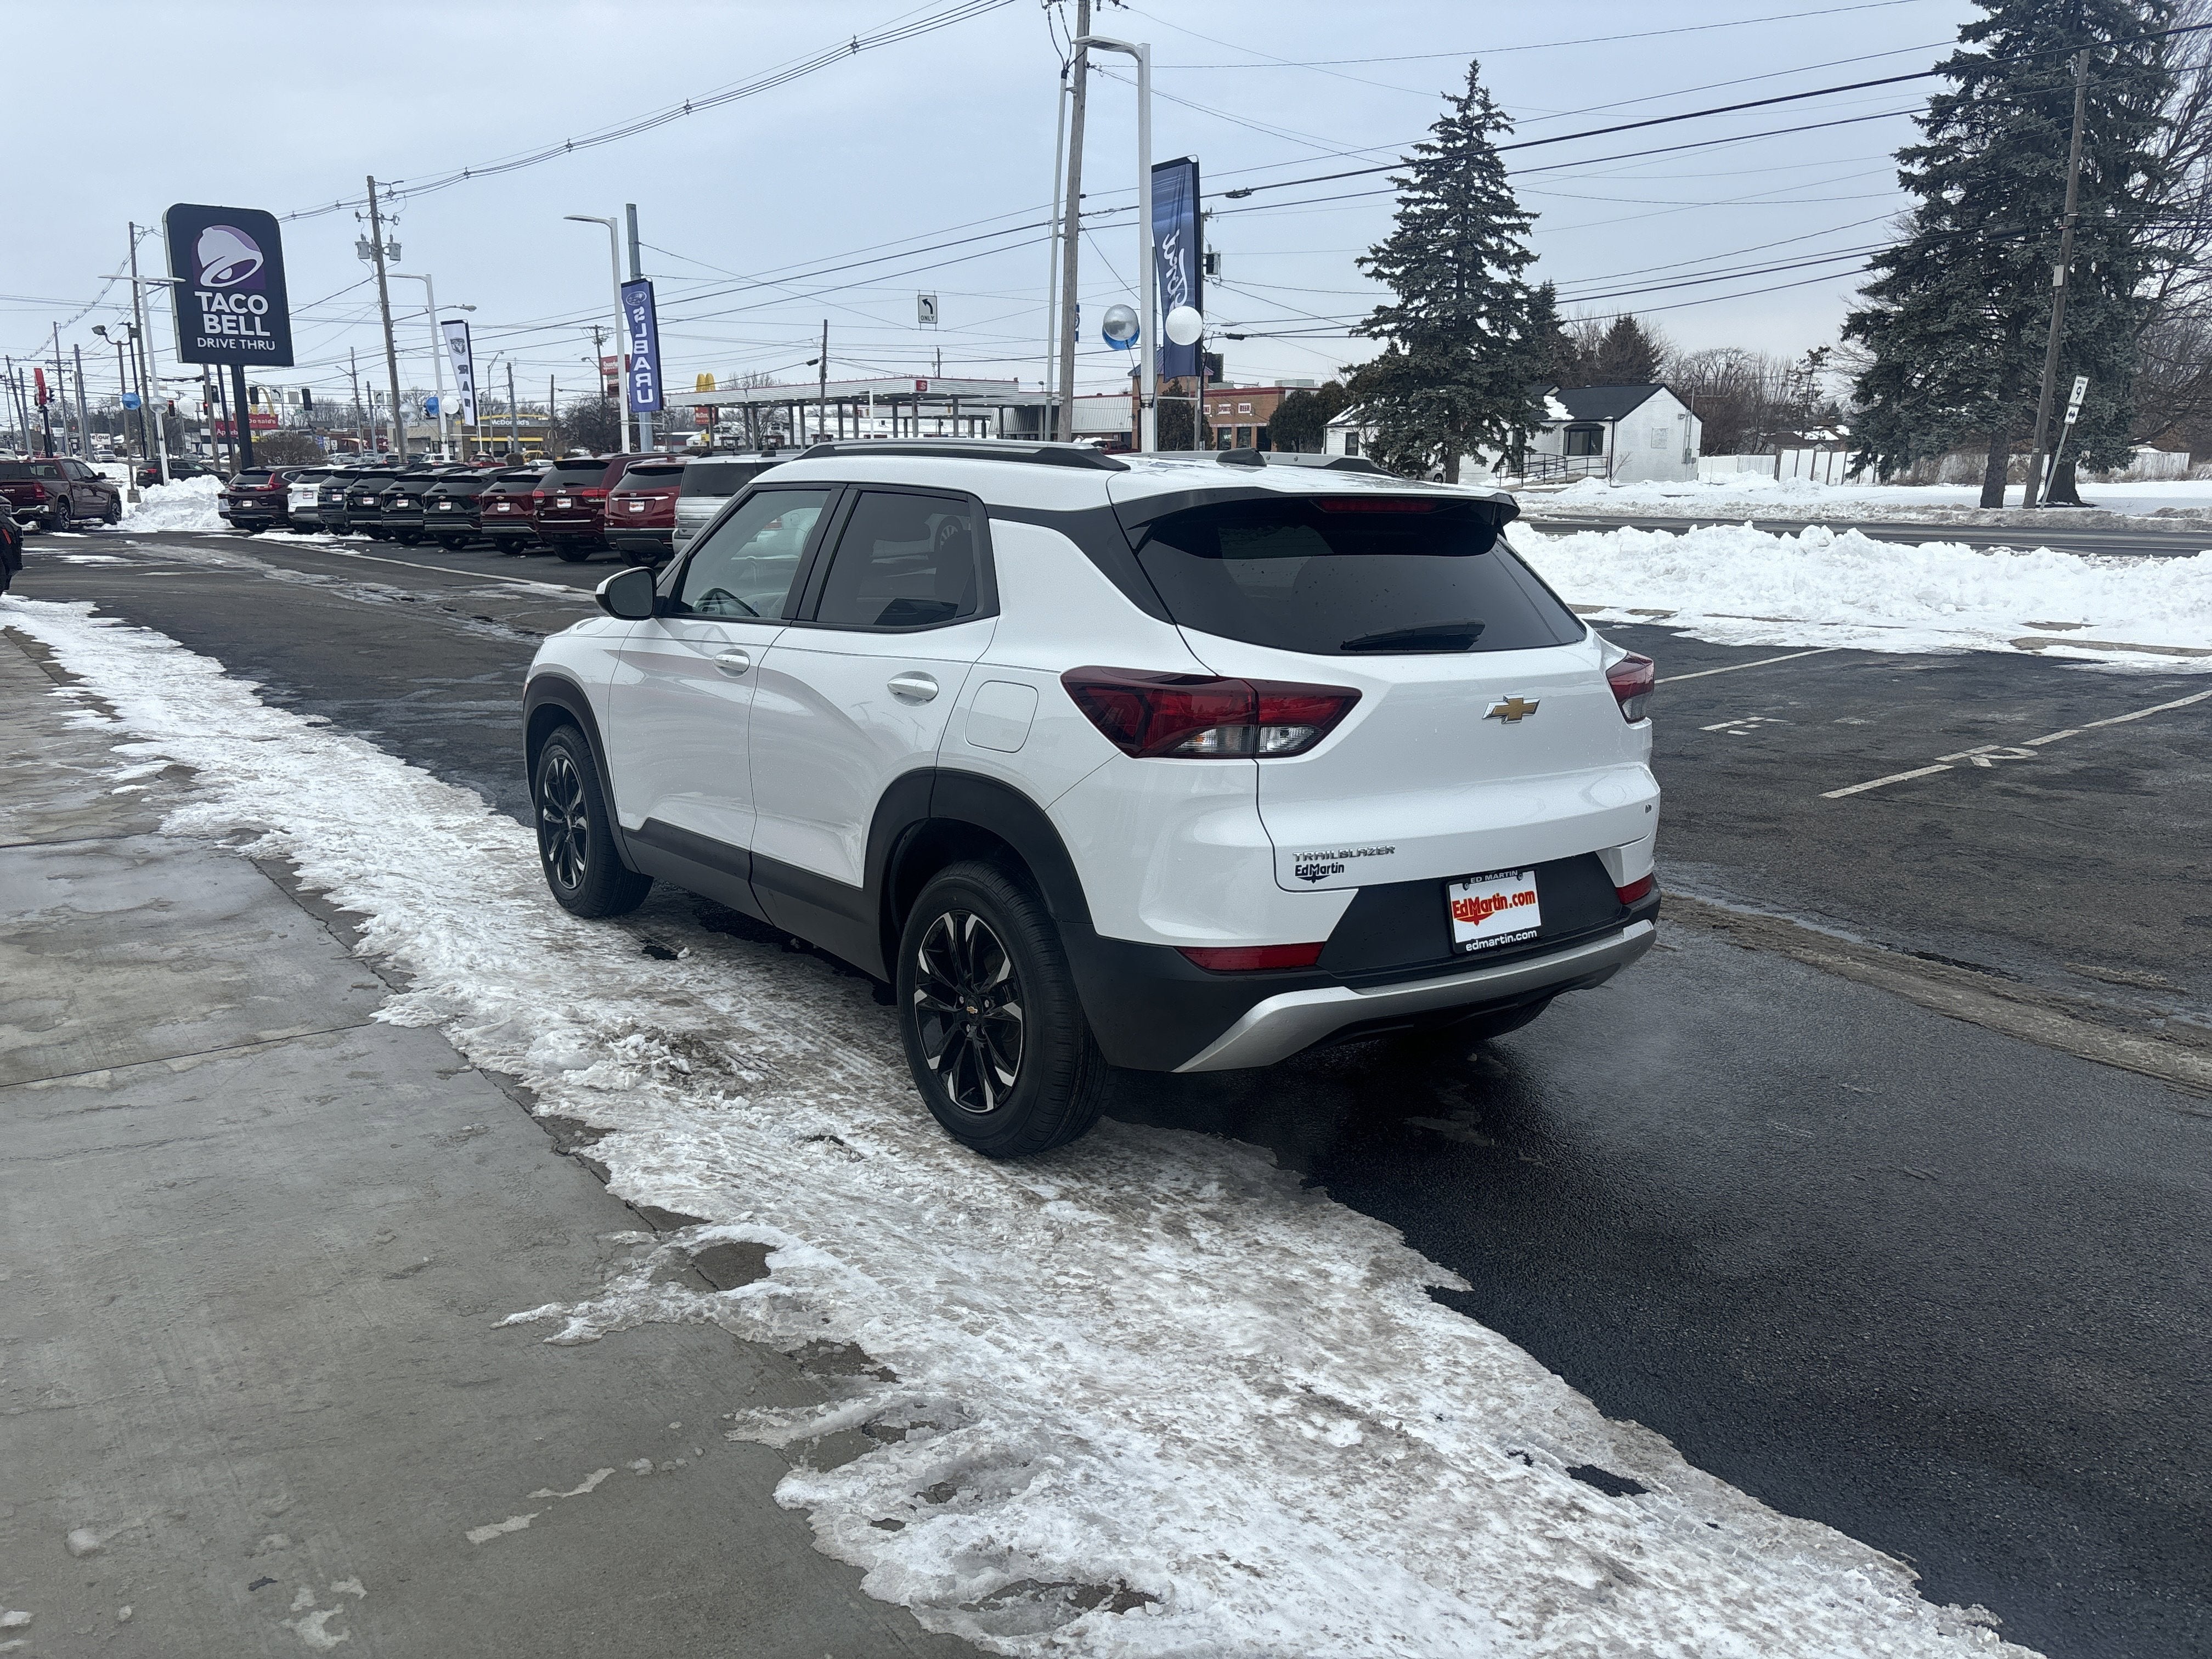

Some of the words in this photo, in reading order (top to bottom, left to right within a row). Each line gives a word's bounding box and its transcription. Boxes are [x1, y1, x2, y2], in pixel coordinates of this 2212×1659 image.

[194, 291, 268, 315] TACO
[203, 313, 270, 336] BELL
[197, 337, 236, 349] DRIVE
[239, 339, 275, 351] THRU
[2076, 386, 2082, 402] 9
[1293, 844, 1396, 862] TRAILBLAZER
[1485, 870, 1519, 882] MARTIN
[1452, 890, 1536, 919] EdMartin.com
[1465, 929, 1538, 952] edmartin.com
